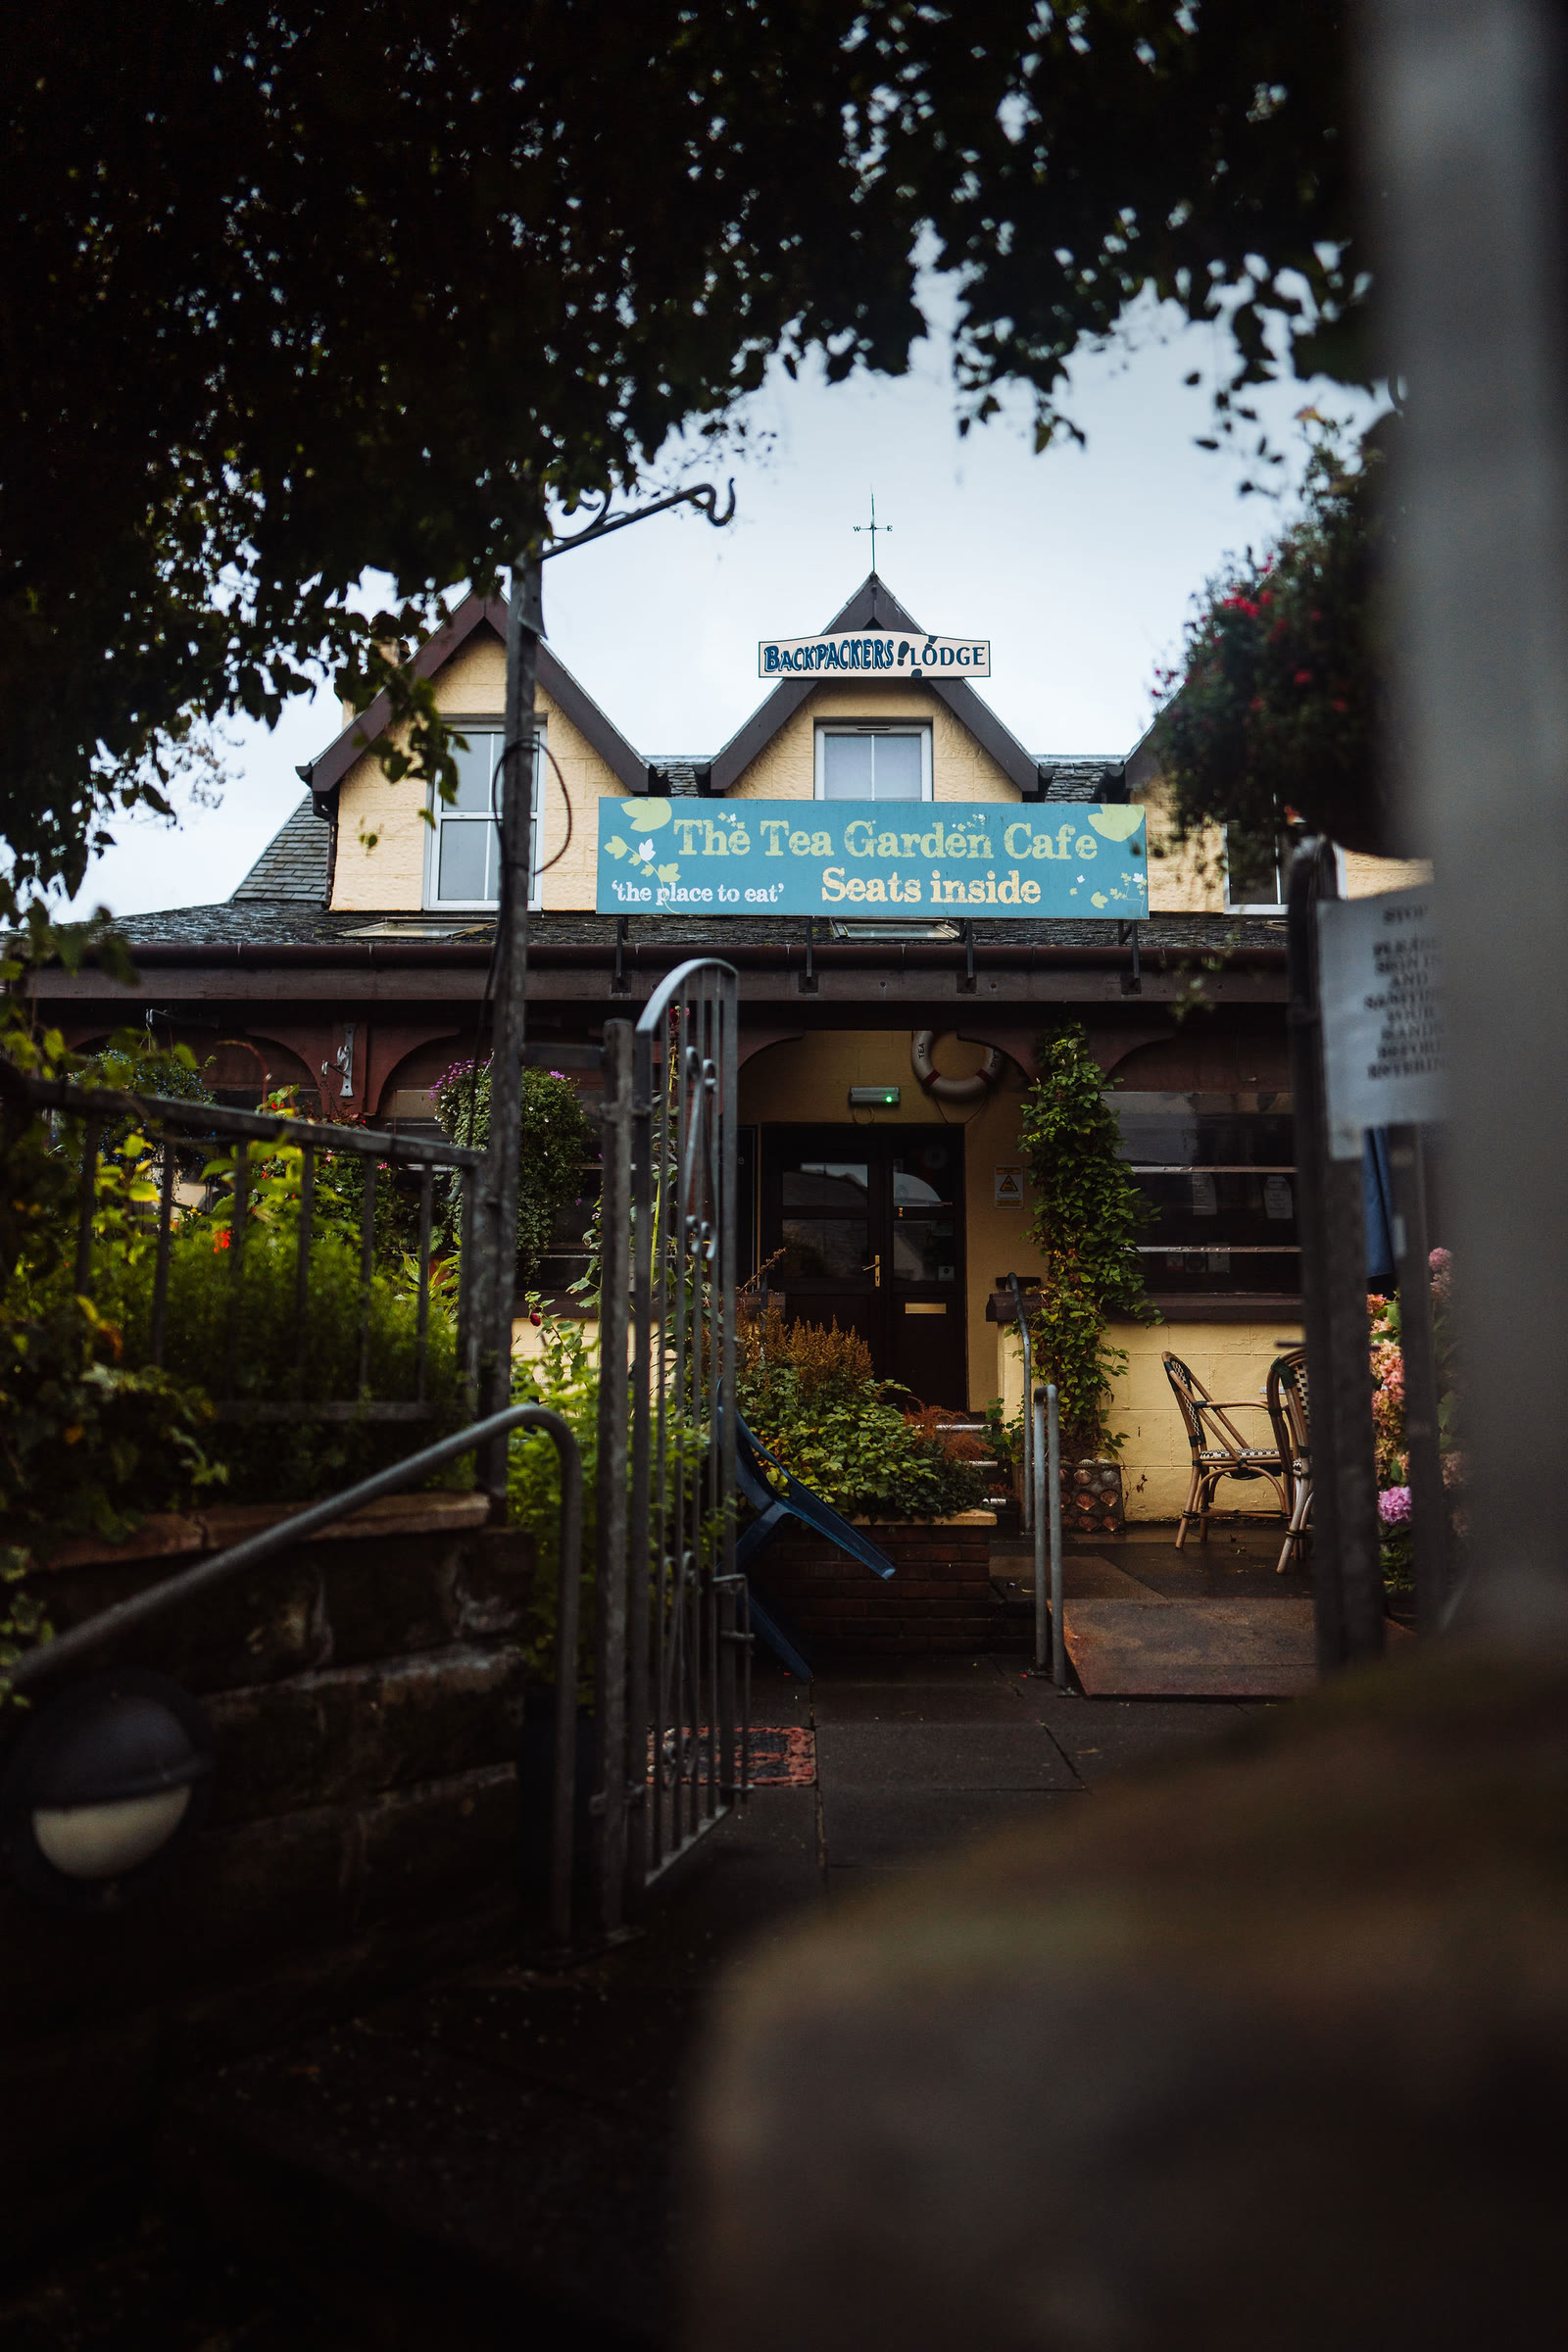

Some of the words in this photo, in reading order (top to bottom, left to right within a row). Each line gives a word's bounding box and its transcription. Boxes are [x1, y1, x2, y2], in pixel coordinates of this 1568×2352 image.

[763, 638, 894, 672] BACKPACKERS
[909, 646, 986, 666] LODGE
[673, 819, 751, 857] The
[760, 819, 834, 857] Tea
[844, 820, 995, 858] Garden
[1004, 822, 1098, 860] Cafe
[656, 882, 713, 906] place
[717, 884, 740, 903] to
[821, 867, 922, 903] Seats
[930, 869, 1042, 904] inside
